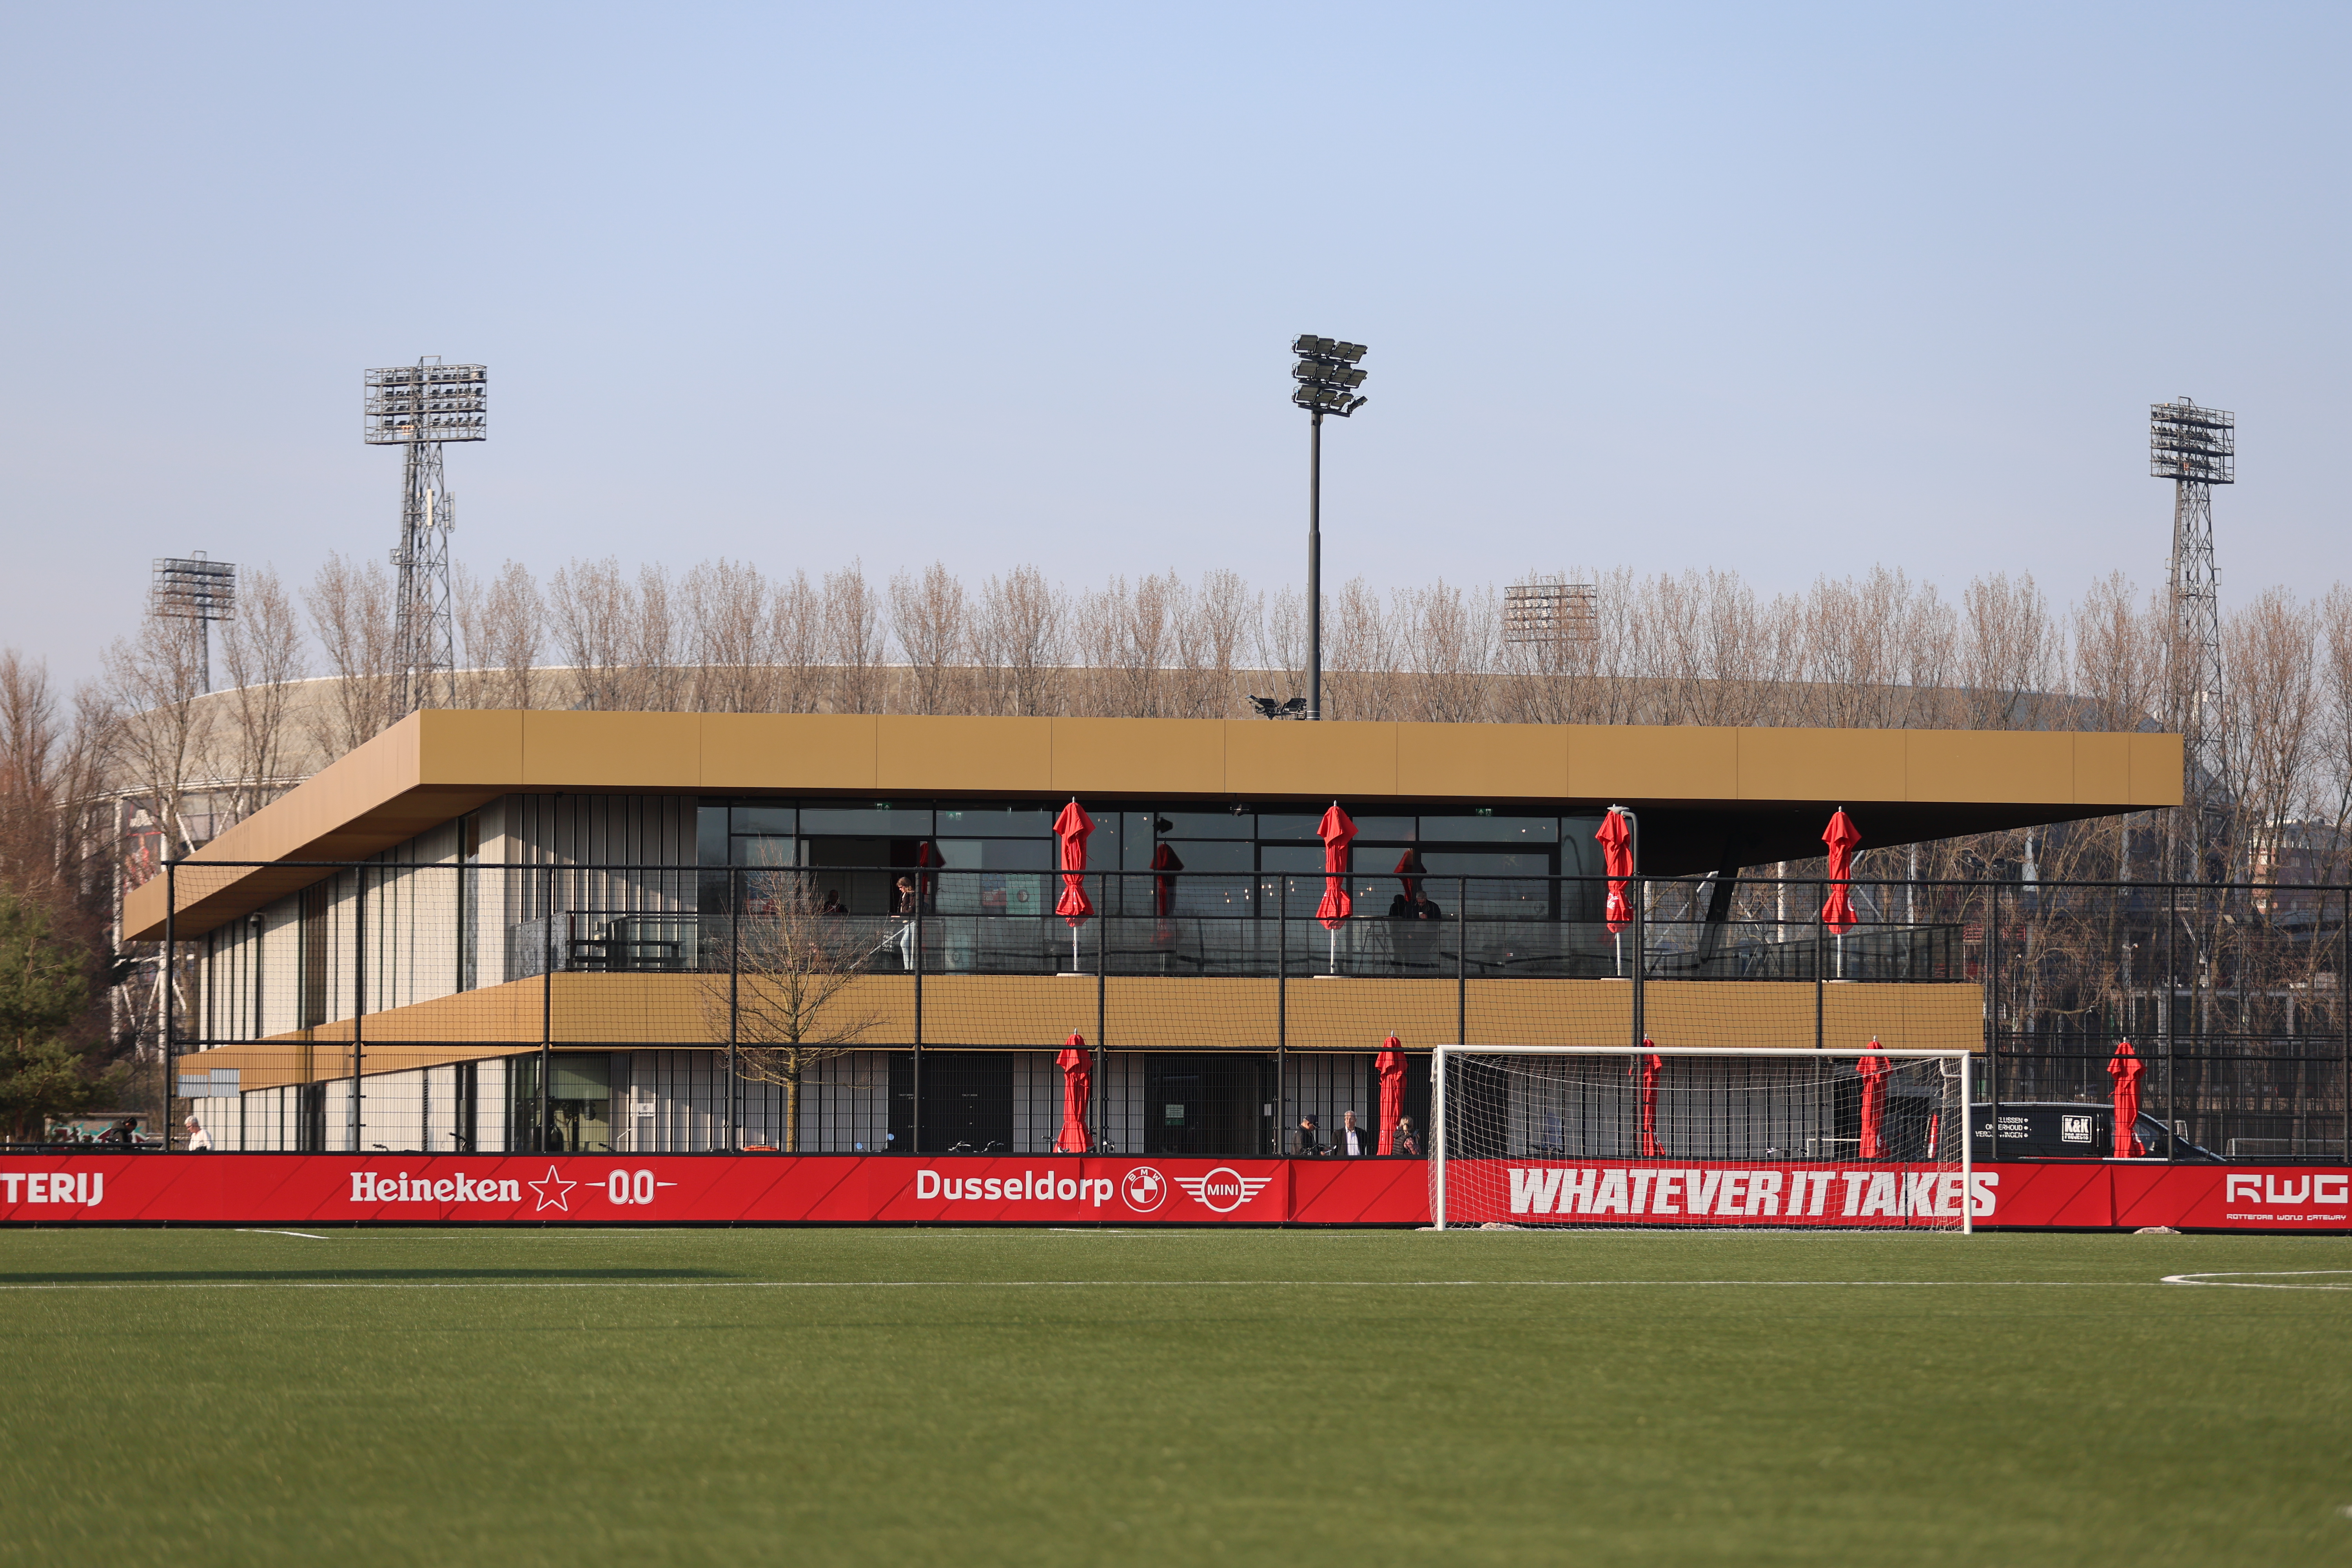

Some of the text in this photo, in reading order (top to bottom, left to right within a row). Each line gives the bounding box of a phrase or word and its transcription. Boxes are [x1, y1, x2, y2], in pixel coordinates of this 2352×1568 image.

[2065, 1118, 2089, 1133] K&K
[0, 1173, 103, 1206] TERIJ
[350, 1172, 521, 1202] Heineken
[917, 1170, 1113, 1207] Dusseldorp
[1128, 1169, 1161, 1181] BMW
[2227, 1174, 2348, 1203] RWG
[1207, 1184, 1238, 1196] MINI
[1507, 1169, 1999, 1216] WHATEVER IT TAKES
